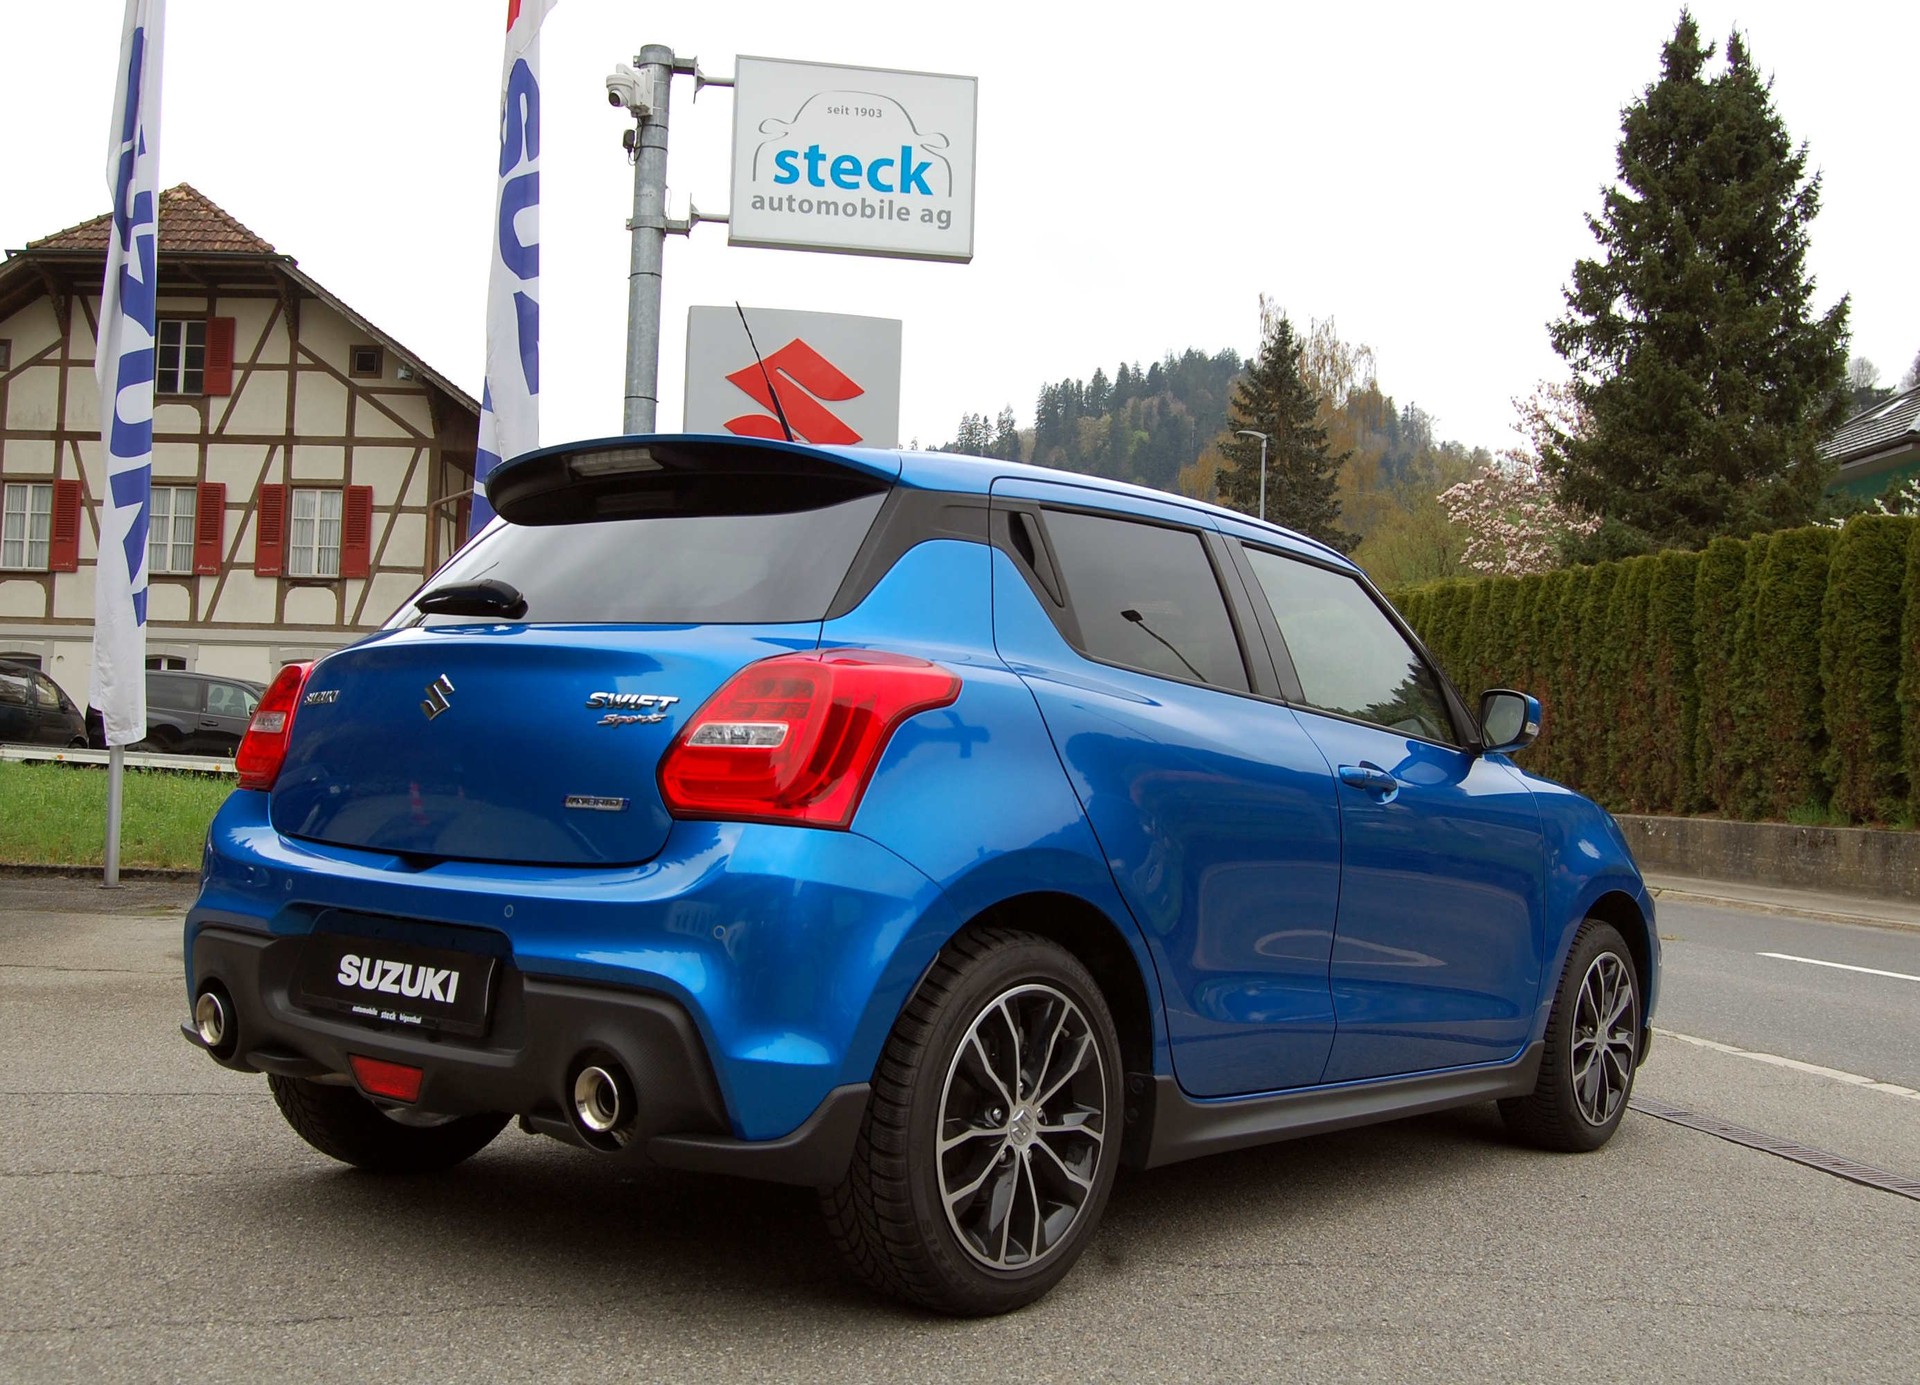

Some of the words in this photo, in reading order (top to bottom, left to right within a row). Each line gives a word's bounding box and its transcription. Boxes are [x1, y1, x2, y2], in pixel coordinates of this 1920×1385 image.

[827, 105, 850, 116] seit
[854, 107, 883, 118] 1903
[773, 144, 934, 196] steck
[751, 194, 911, 222] automobile
[919, 208, 952, 230] ag
[585, 691, 680, 711] SWIFT
[596, 713, 667, 728] Sport
[337, 954, 460, 1004] SUZUKI
